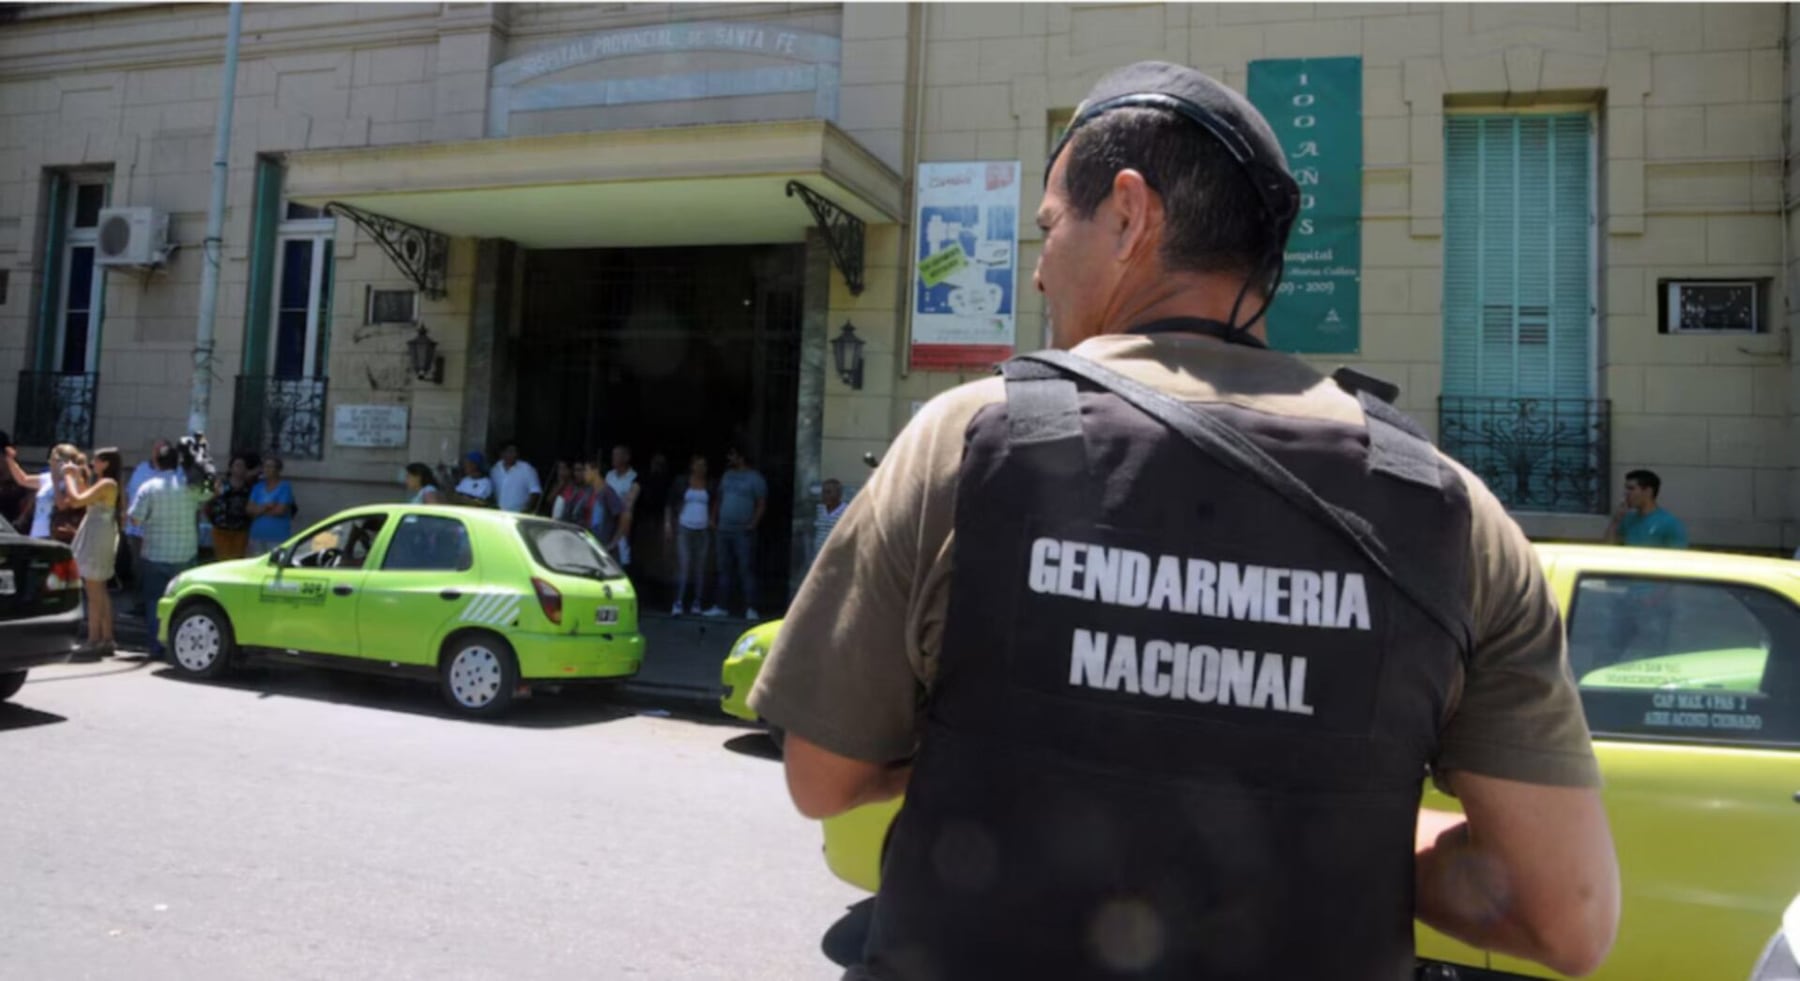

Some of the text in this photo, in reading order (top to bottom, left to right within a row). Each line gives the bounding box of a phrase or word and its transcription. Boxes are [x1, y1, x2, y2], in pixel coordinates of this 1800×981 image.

[591, 29, 674, 55] PROVINCIAL
[715, 27, 764, 49] SANTA
[776, 32, 799, 54] FE
[1028, 537, 1371, 630] GENDARMERIA
[1069, 628, 1314, 715] NACIONAL
